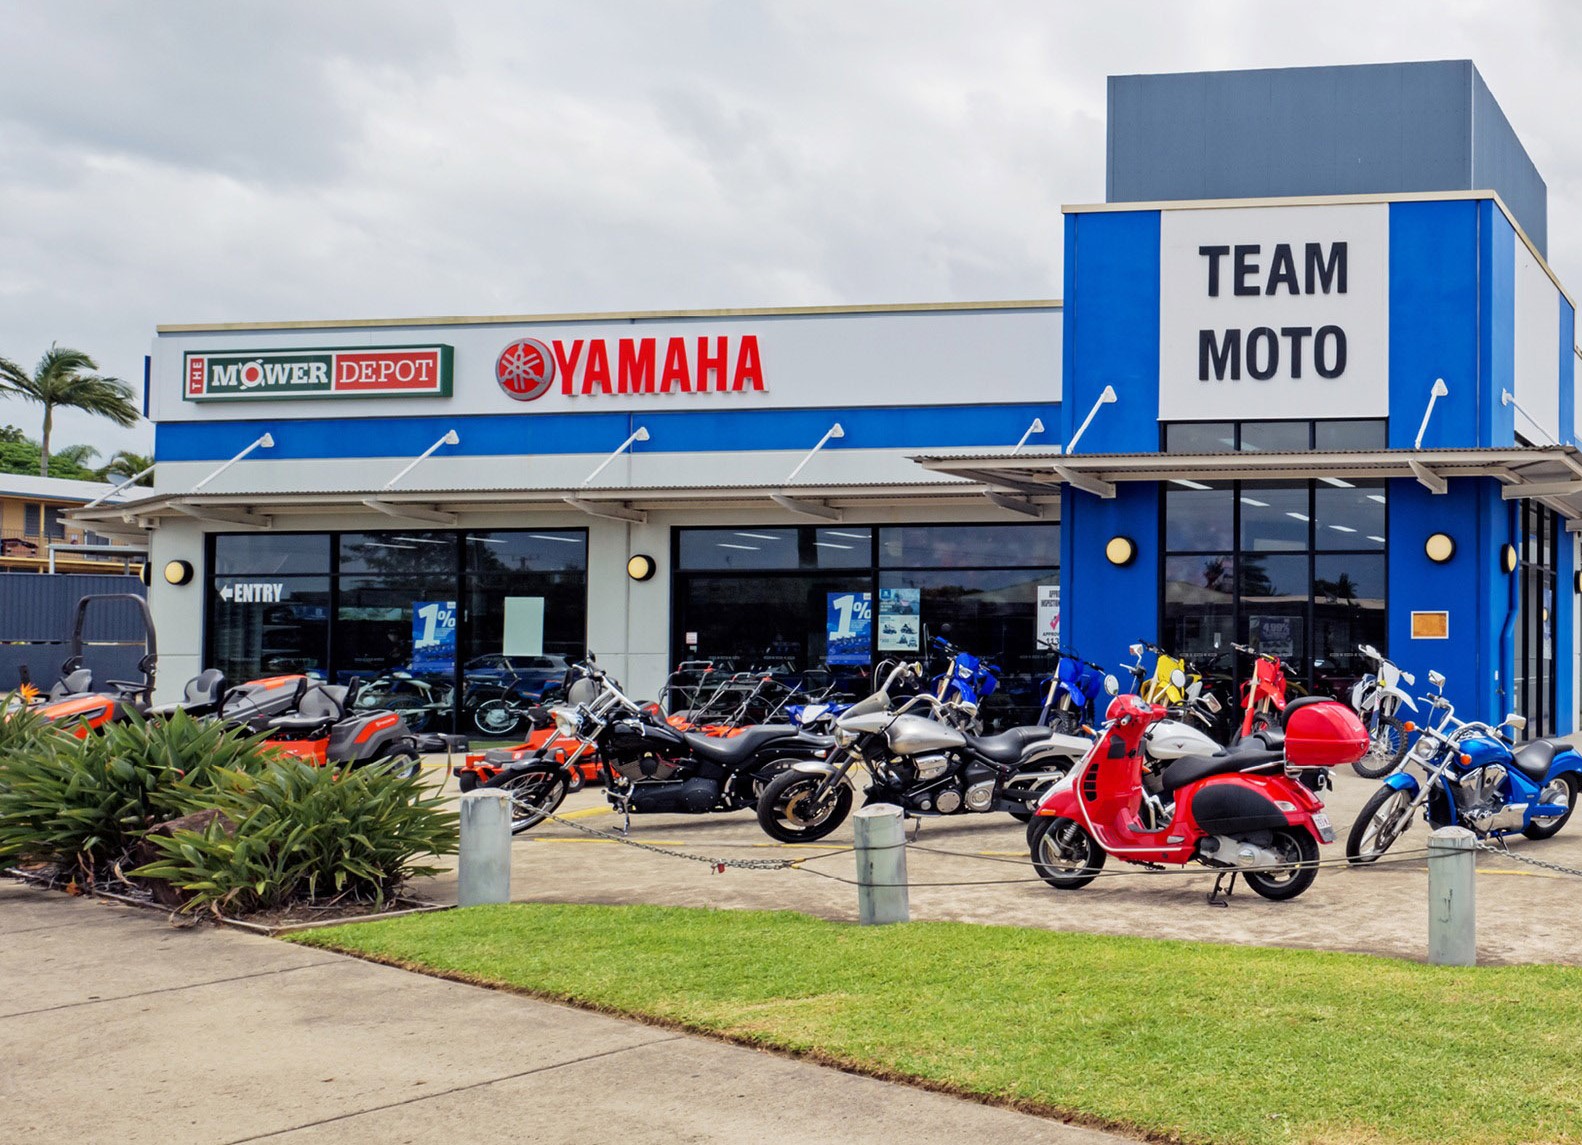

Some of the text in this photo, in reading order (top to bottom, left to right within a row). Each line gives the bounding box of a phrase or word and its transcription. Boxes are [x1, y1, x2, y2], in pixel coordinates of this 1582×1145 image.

[1199, 242, 1347, 297] TEAM
[192, 359, 433, 390] THE MOWER DEPOT
[552, 335, 766, 396] YAMAHA
[1199, 325, 1347, 381] MOTO
[234, 584, 283, 603] ENTRY
[414, 603, 456, 649] 1%
[829, 595, 871, 641] 1%
